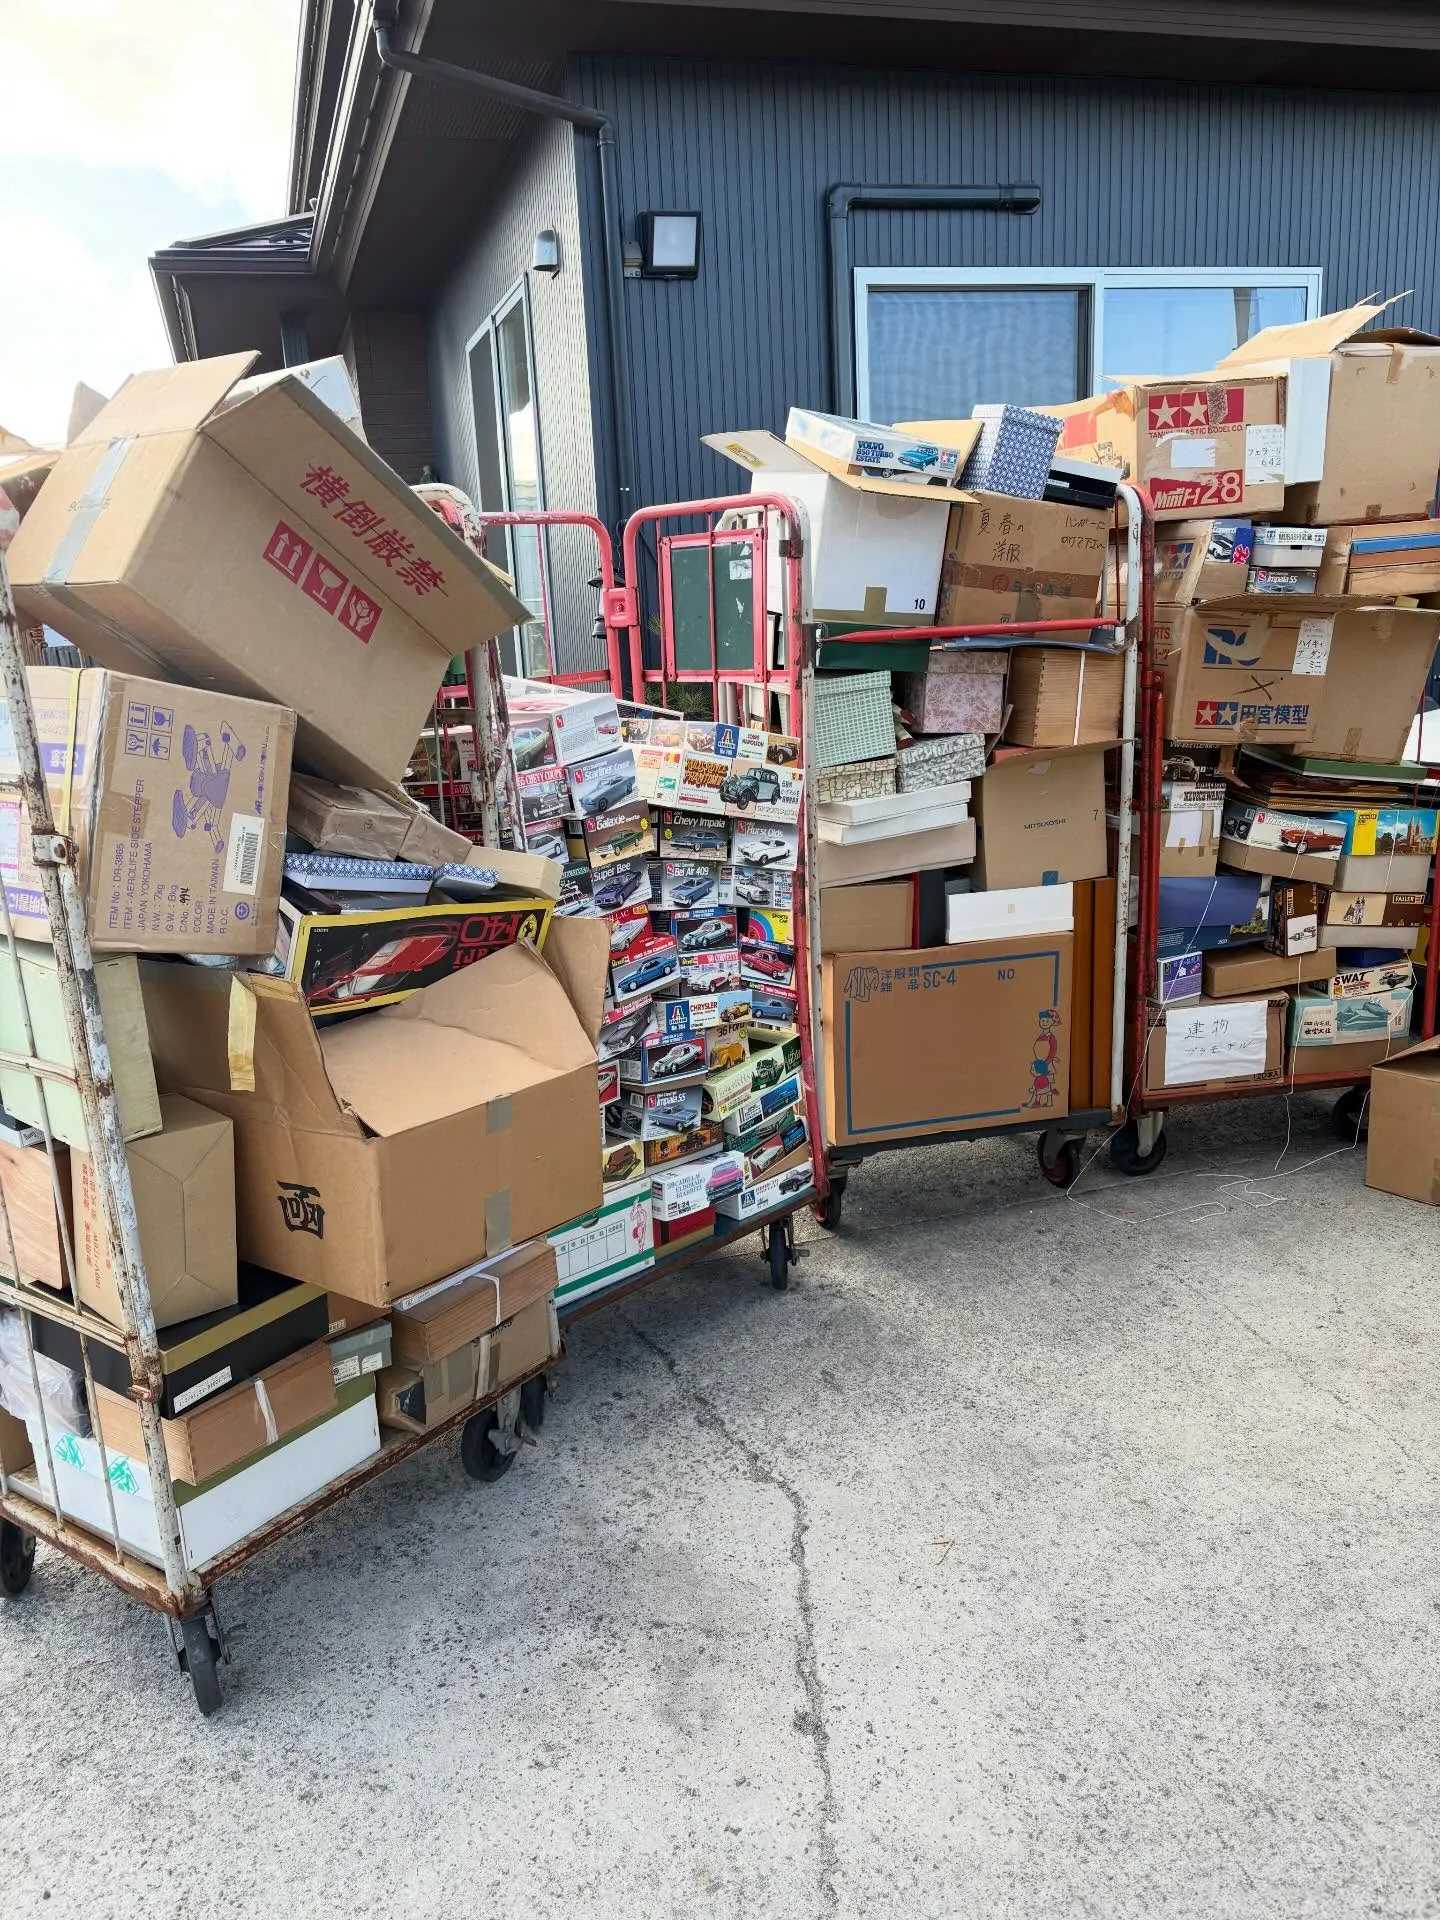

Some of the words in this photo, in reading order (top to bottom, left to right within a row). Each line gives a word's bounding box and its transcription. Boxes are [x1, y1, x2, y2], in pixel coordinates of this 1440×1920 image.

[1176, 427, 1206, 435] ASTIC
[858, 440, 884, 451] VOLVO
[871, 450, 894, 458] TURBO
[1261, 457, 1281, 466] 642
[1200, 471, 1241, 504] 28
[299, 465, 447, 597] 横倒厳禁
[992, 539, 1021, 563] 洋服
[1266, 575, 1290, 584] Impala
[1289, 575, 1299, 584] SS
[914, 598, 926, 611] 10
[1239, 704, 1310, 725] 田宮模型
[132, 779, 145, 823] STEPPER
[596, 814, 626, 831] Galaxie
[673, 815, 700, 828] Chevy
[699, 817, 726, 828] Impala
[1024, 818, 1066, 830] MITSUKOSHI
[1093, 809, 1099, 821] 7
[130, 826, 140, 849] SIDE
[126, 851, 139, 898] AEROLIFE
[141, 842, 152, 897] YOKOHAMA
[208, 858, 220, 894] TAIWAN
[593, 868, 615, 882] Super
[616, 862, 631, 874] Bee
[674, 867, 686, 877] Bel
[695, 867, 709, 876] 409
[111, 890, 120, 902] No
[109, 903, 119, 930] ITEM
[124, 904, 134, 930] ITEM
[138, 900, 148, 931] JAPAN
[152, 910, 162, 931] N.W.
[166, 909, 175, 932] G.W.
[192, 901, 203, 933] COLOR
[206, 908, 217, 934] MADE
[459, 913, 523, 944] F40
[880, 966, 920, 980] 洋服類
[923, 968, 957, 989] SC-4
[1334, 969, 1375, 986] SWAT
[690, 1002, 718, 1012] CHRYSLER
[728, 1021, 745, 1034] Ford
[1184, 1019, 1230, 1039] 建物
